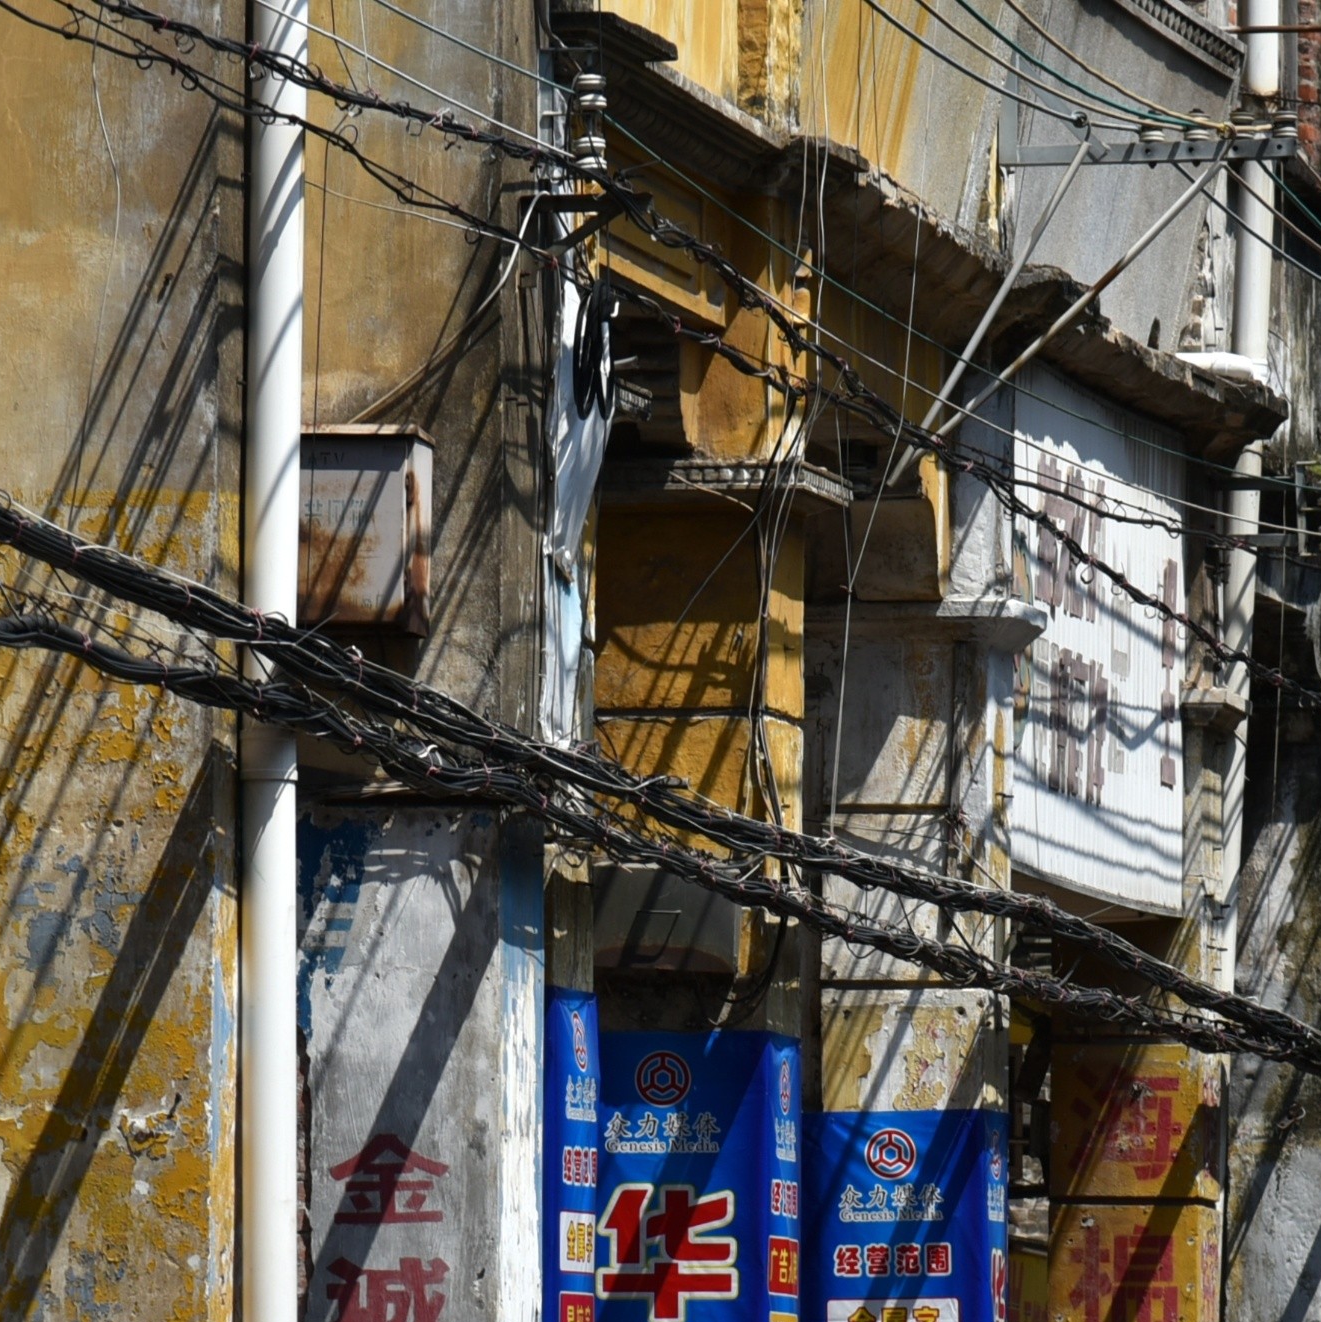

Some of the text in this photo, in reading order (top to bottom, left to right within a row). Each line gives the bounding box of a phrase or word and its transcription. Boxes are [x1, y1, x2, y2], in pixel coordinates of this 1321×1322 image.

[605, 1112, 720, 1138] 众力媒体
[606, 1137, 720, 1153] Genesis Media
[838, 1183, 945, 1210] 众力媒体
[839, 1208, 943, 1222] Genesis Media
[566, 1219, 594, 1264] 金属字
[833, 1241, 953, 1278] 经营范围
